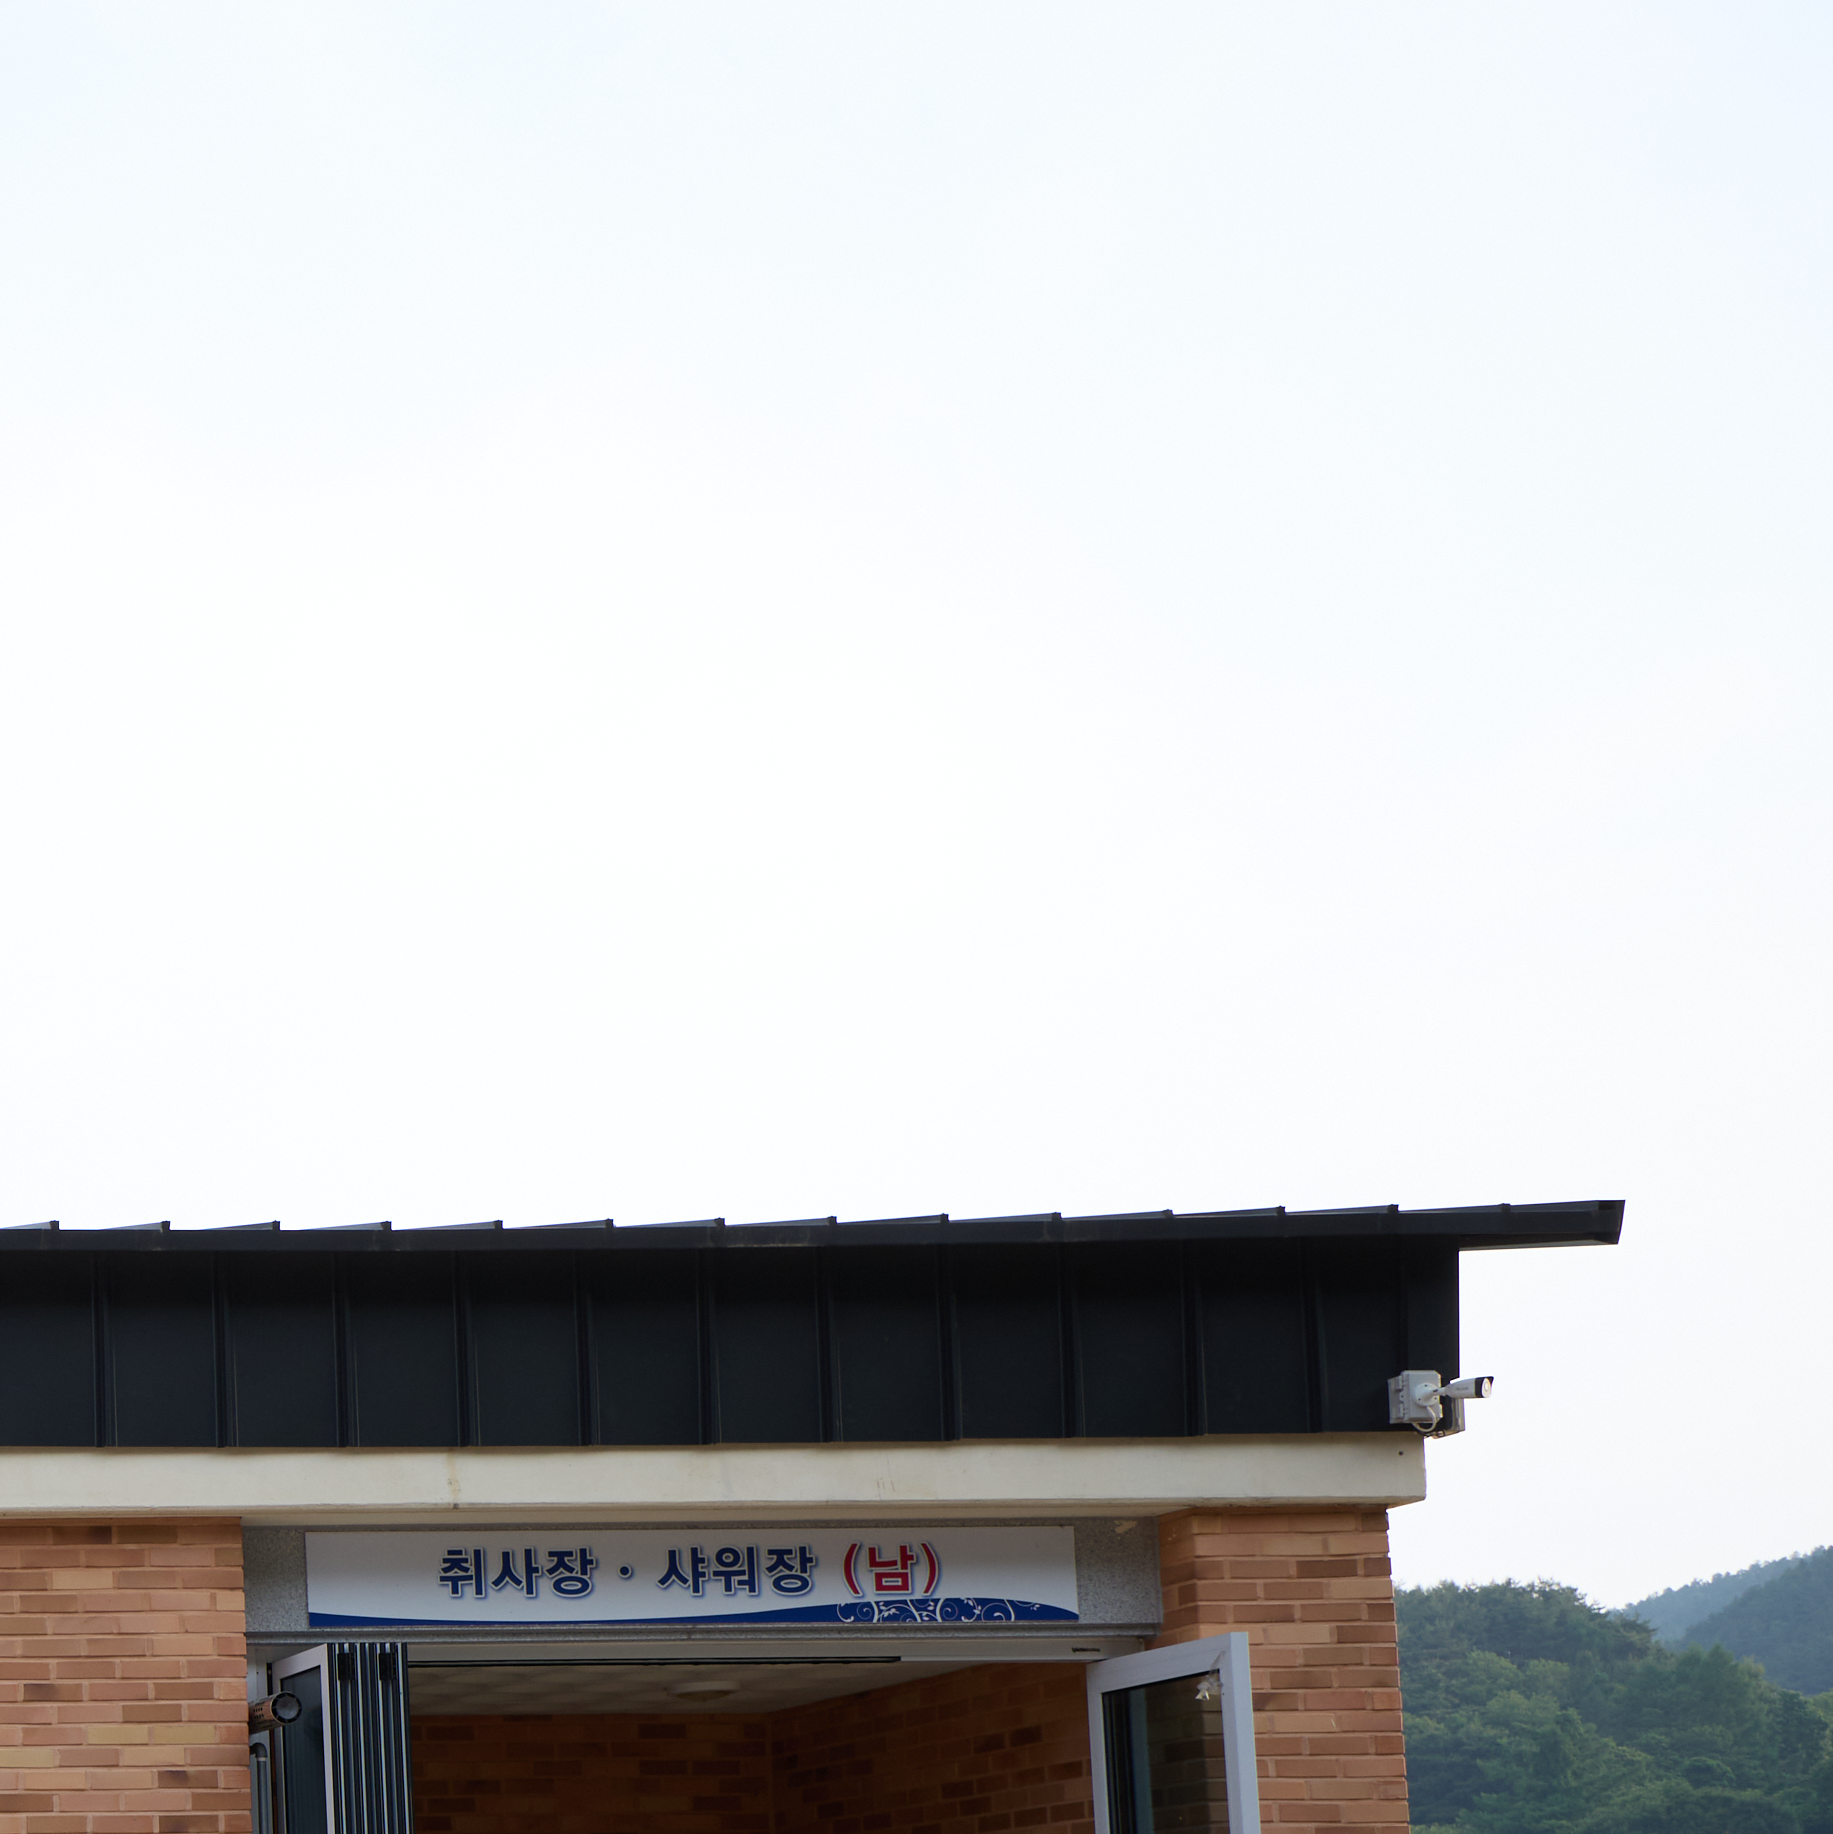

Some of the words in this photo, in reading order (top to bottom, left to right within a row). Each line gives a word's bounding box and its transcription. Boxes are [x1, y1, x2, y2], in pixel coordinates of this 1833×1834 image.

[439, 1546, 596, 1597] 취사장
[658, 1544, 815, 1596] 샤워장
[843, 1541, 939, 1596] (남)
